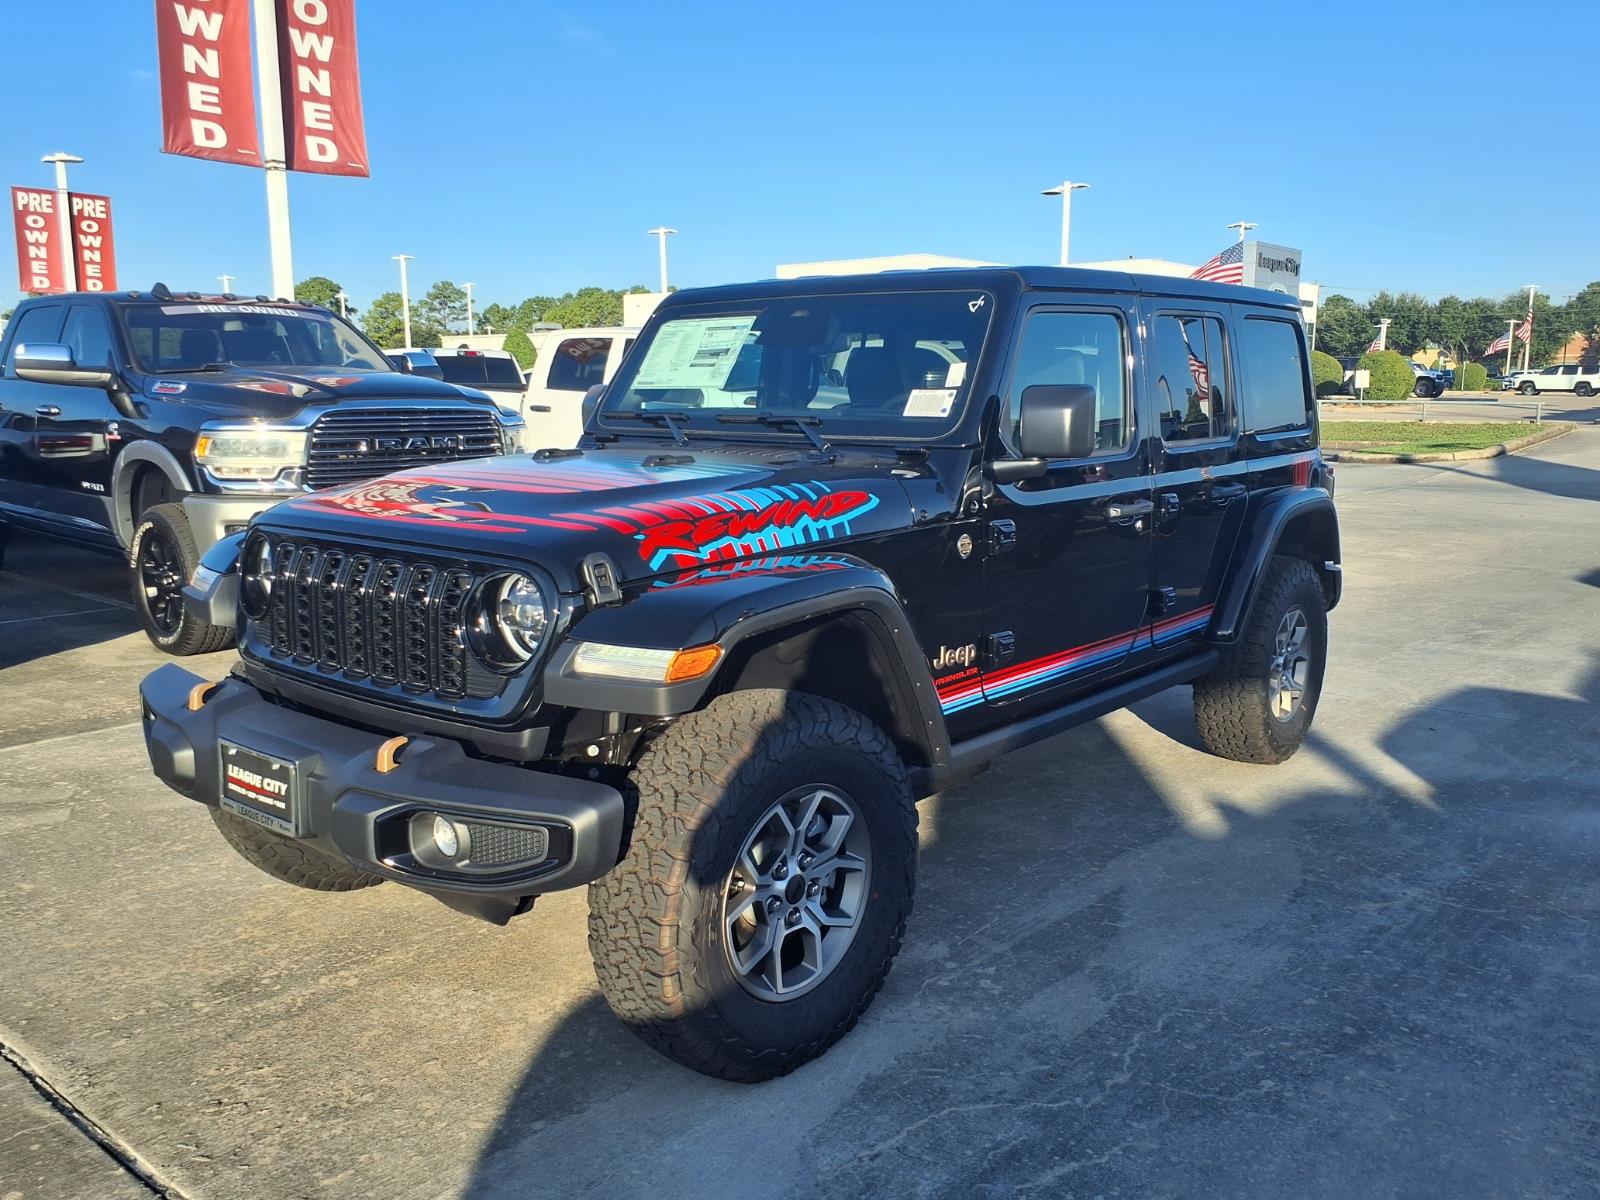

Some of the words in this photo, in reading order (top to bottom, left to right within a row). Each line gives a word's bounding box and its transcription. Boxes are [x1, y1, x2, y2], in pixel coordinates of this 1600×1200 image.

[173, 0, 228, 149] WNED
[288, 0, 339, 163] OWNED
[16, 191, 53, 214] PRE
[72, 197, 107, 219] PRE
[24, 215, 50, 289] OWNED
[79, 220, 104, 291] OWNED
[1257, 252, 1286, 273] League
[1285, 257, 1301, 277] City
[197, 304, 298, 317] PRE-OWNED
[376, 436, 457, 450] RAM
[637, 490, 869, 561] REWIND
[933, 643, 976, 670] Jeep
[227, 764, 263, 788] LEAGUE
[262, 778, 288, 796] CITY
